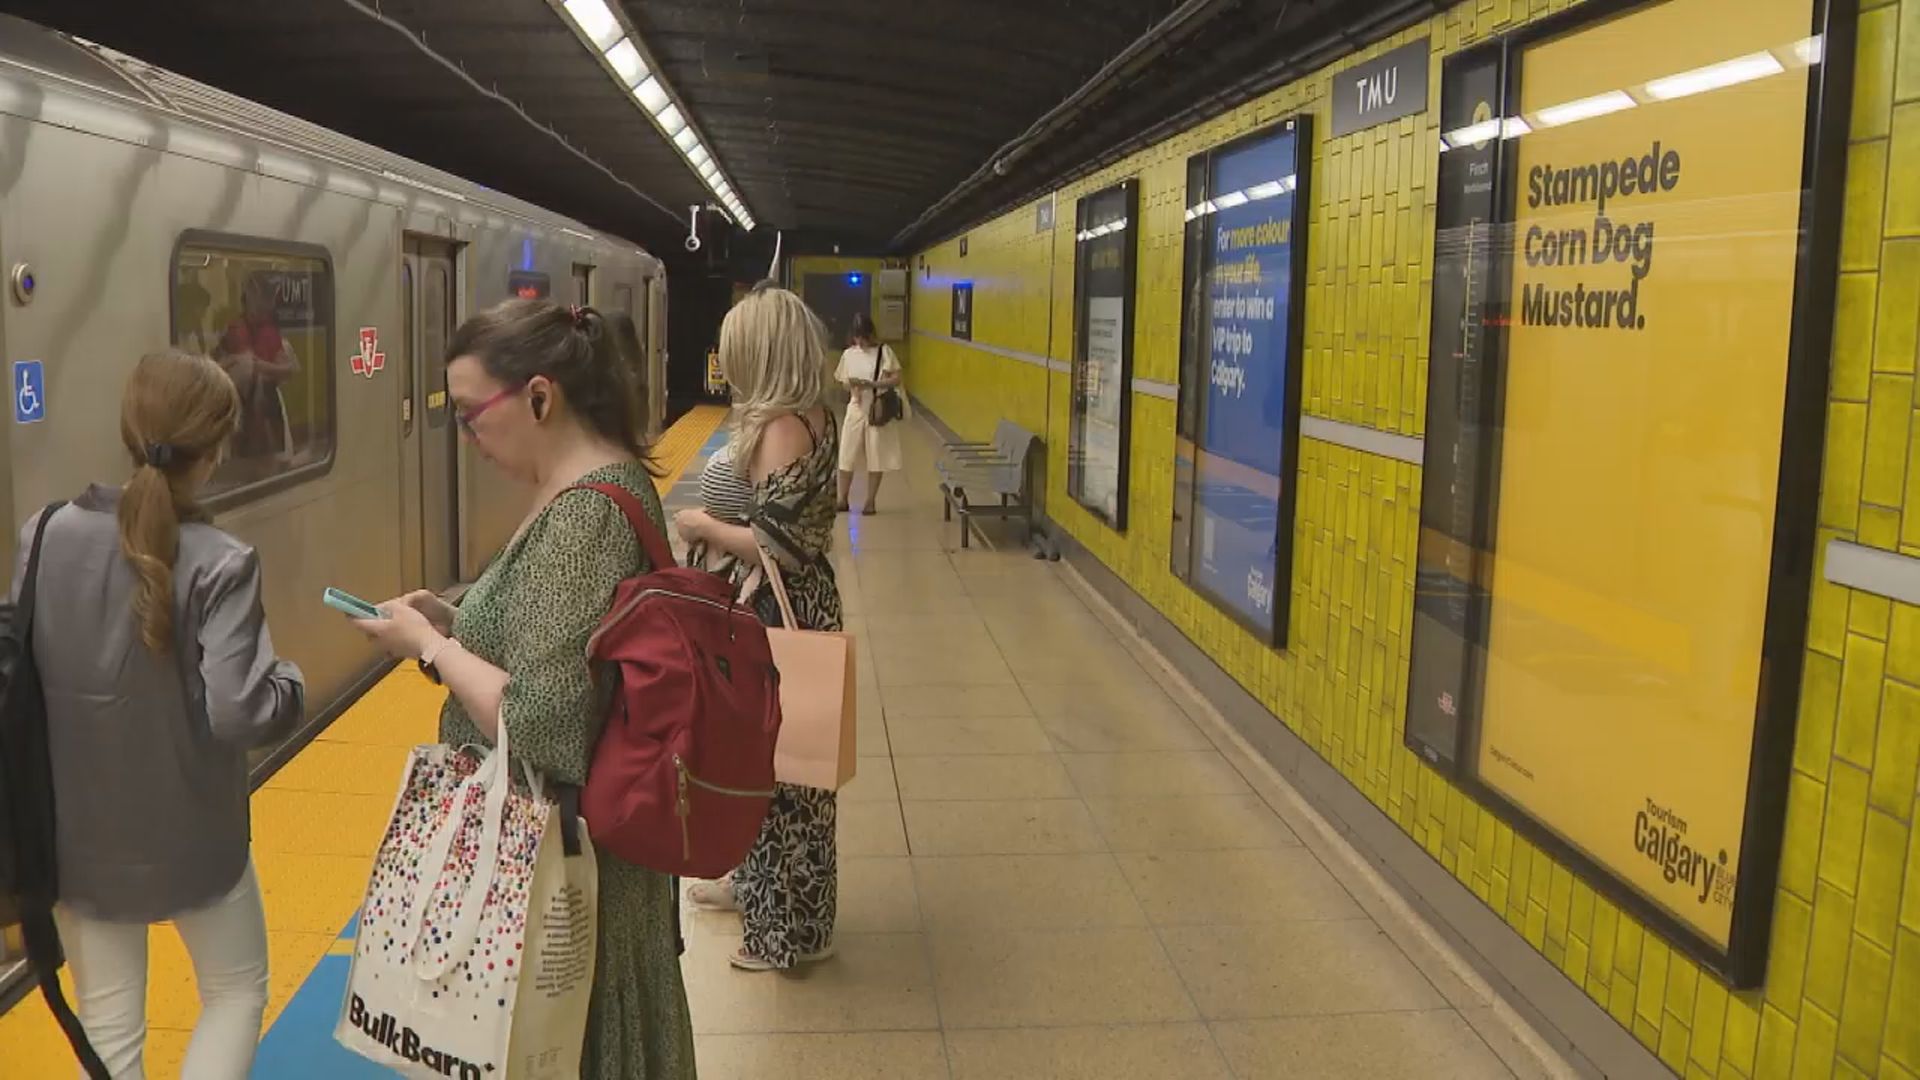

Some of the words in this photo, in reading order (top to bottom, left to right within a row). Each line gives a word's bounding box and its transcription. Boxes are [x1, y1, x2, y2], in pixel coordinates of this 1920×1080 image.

[1356, 66, 1398, 115] TMU
[1528, 141, 1681, 217] Stampede
[1217, 226, 1231, 252] For
[1231, 225, 1255, 250] more
[1256, 215, 1291, 247] colour
[1524, 224, 1587, 267] Corn
[1592, 216, 1655, 280] Dog
[1213, 290, 1235, 319] enter
[1236, 291, 1246, 319] to
[1247, 288, 1265, 320] win
[1266, 296, 1274, 320] a
[1521, 278, 1646, 331] Mustard.
[1213, 326, 1226, 353] VIP
[1226, 323, 1241, 362] trip
[1242, 327, 1253, 355] to
[1211, 359, 1246, 398] Calgary.
[1645, 797, 1688, 835] Tourism
[1634, 811, 1717, 905] Calgary
